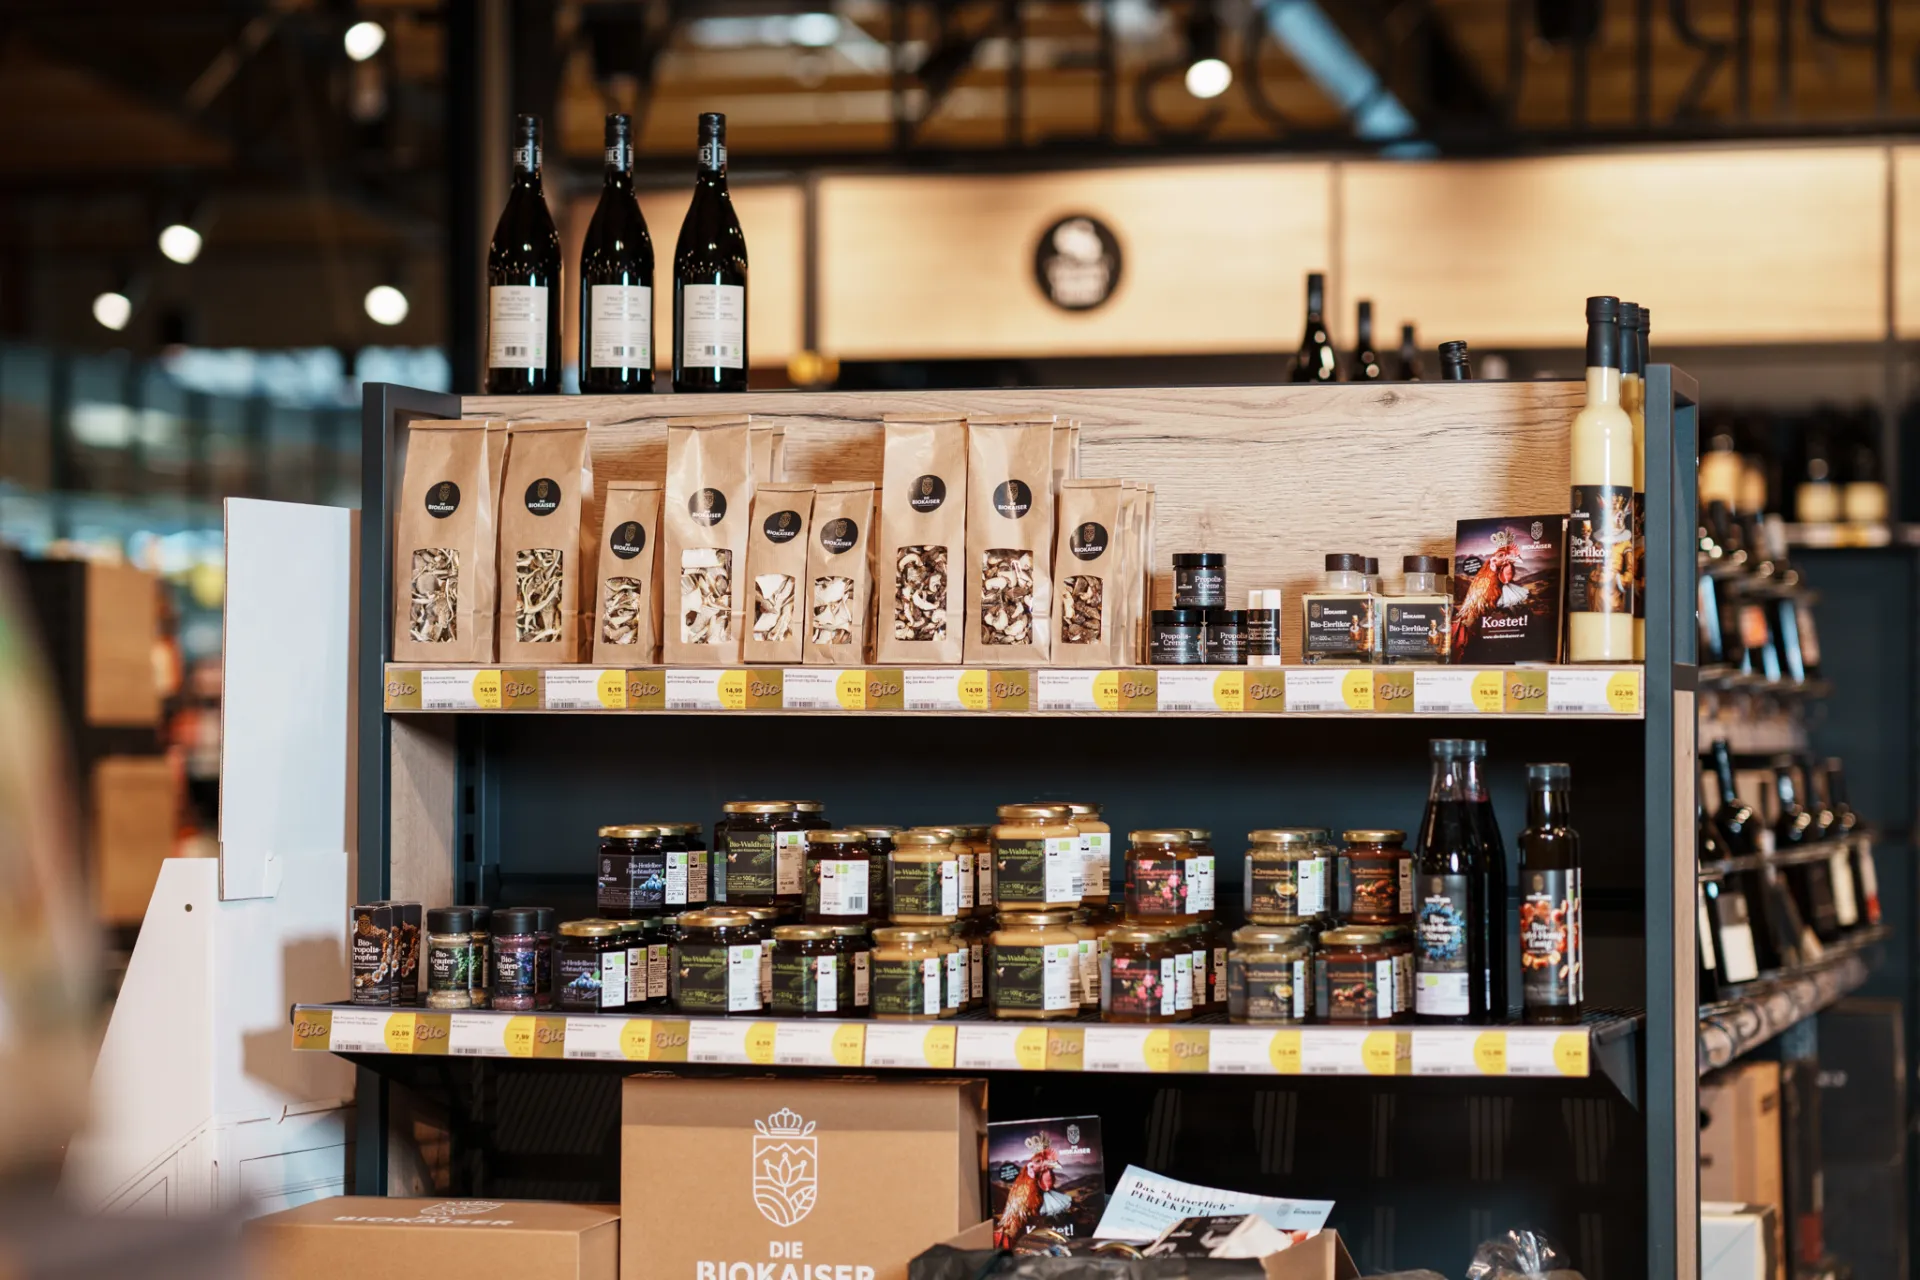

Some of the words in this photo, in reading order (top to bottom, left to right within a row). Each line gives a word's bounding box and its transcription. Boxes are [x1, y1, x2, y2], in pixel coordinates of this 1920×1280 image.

[1481, 614, 1528, 628] Kostet!
[387, 680, 418, 697] Bio
[505, 681, 537, 698] Bio
[607, 686, 622, 694] 8,19
[630, 681, 661, 697] Bio
[750, 681, 782, 697] Bio
[869, 681, 901, 697] Bio
[994, 681, 1026, 698] Bio
[1123, 681, 1155, 698] Bio
[1249, 682, 1283, 700] Bio
[1380, 682, 1413, 700] Bio
[1511, 683, 1544, 700] Bio
[357, 938, 373, 947] Bio-
[435, 950, 450, 958] Bio-
[500, 955, 516, 963] Bio-
[434, 963, 449, 972] Salz
[500, 968, 515, 977] Salz
[296, 1021, 328, 1038] Bio
[416, 1024, 448, 1041] Bio
[515, 1033, 530, 1041] 7,99
[656, 1032, 688, 1048] Bio
[1134, 1181, 1155, 1194] Das
[1130, 1190, 1196, 1214] PERFEKTE
[333, 1216, 514, 1226] BIOKAISER
[769, 1240, 804, 1259] DIE
[696, 1260, 876, 1280] BIOKAISER
